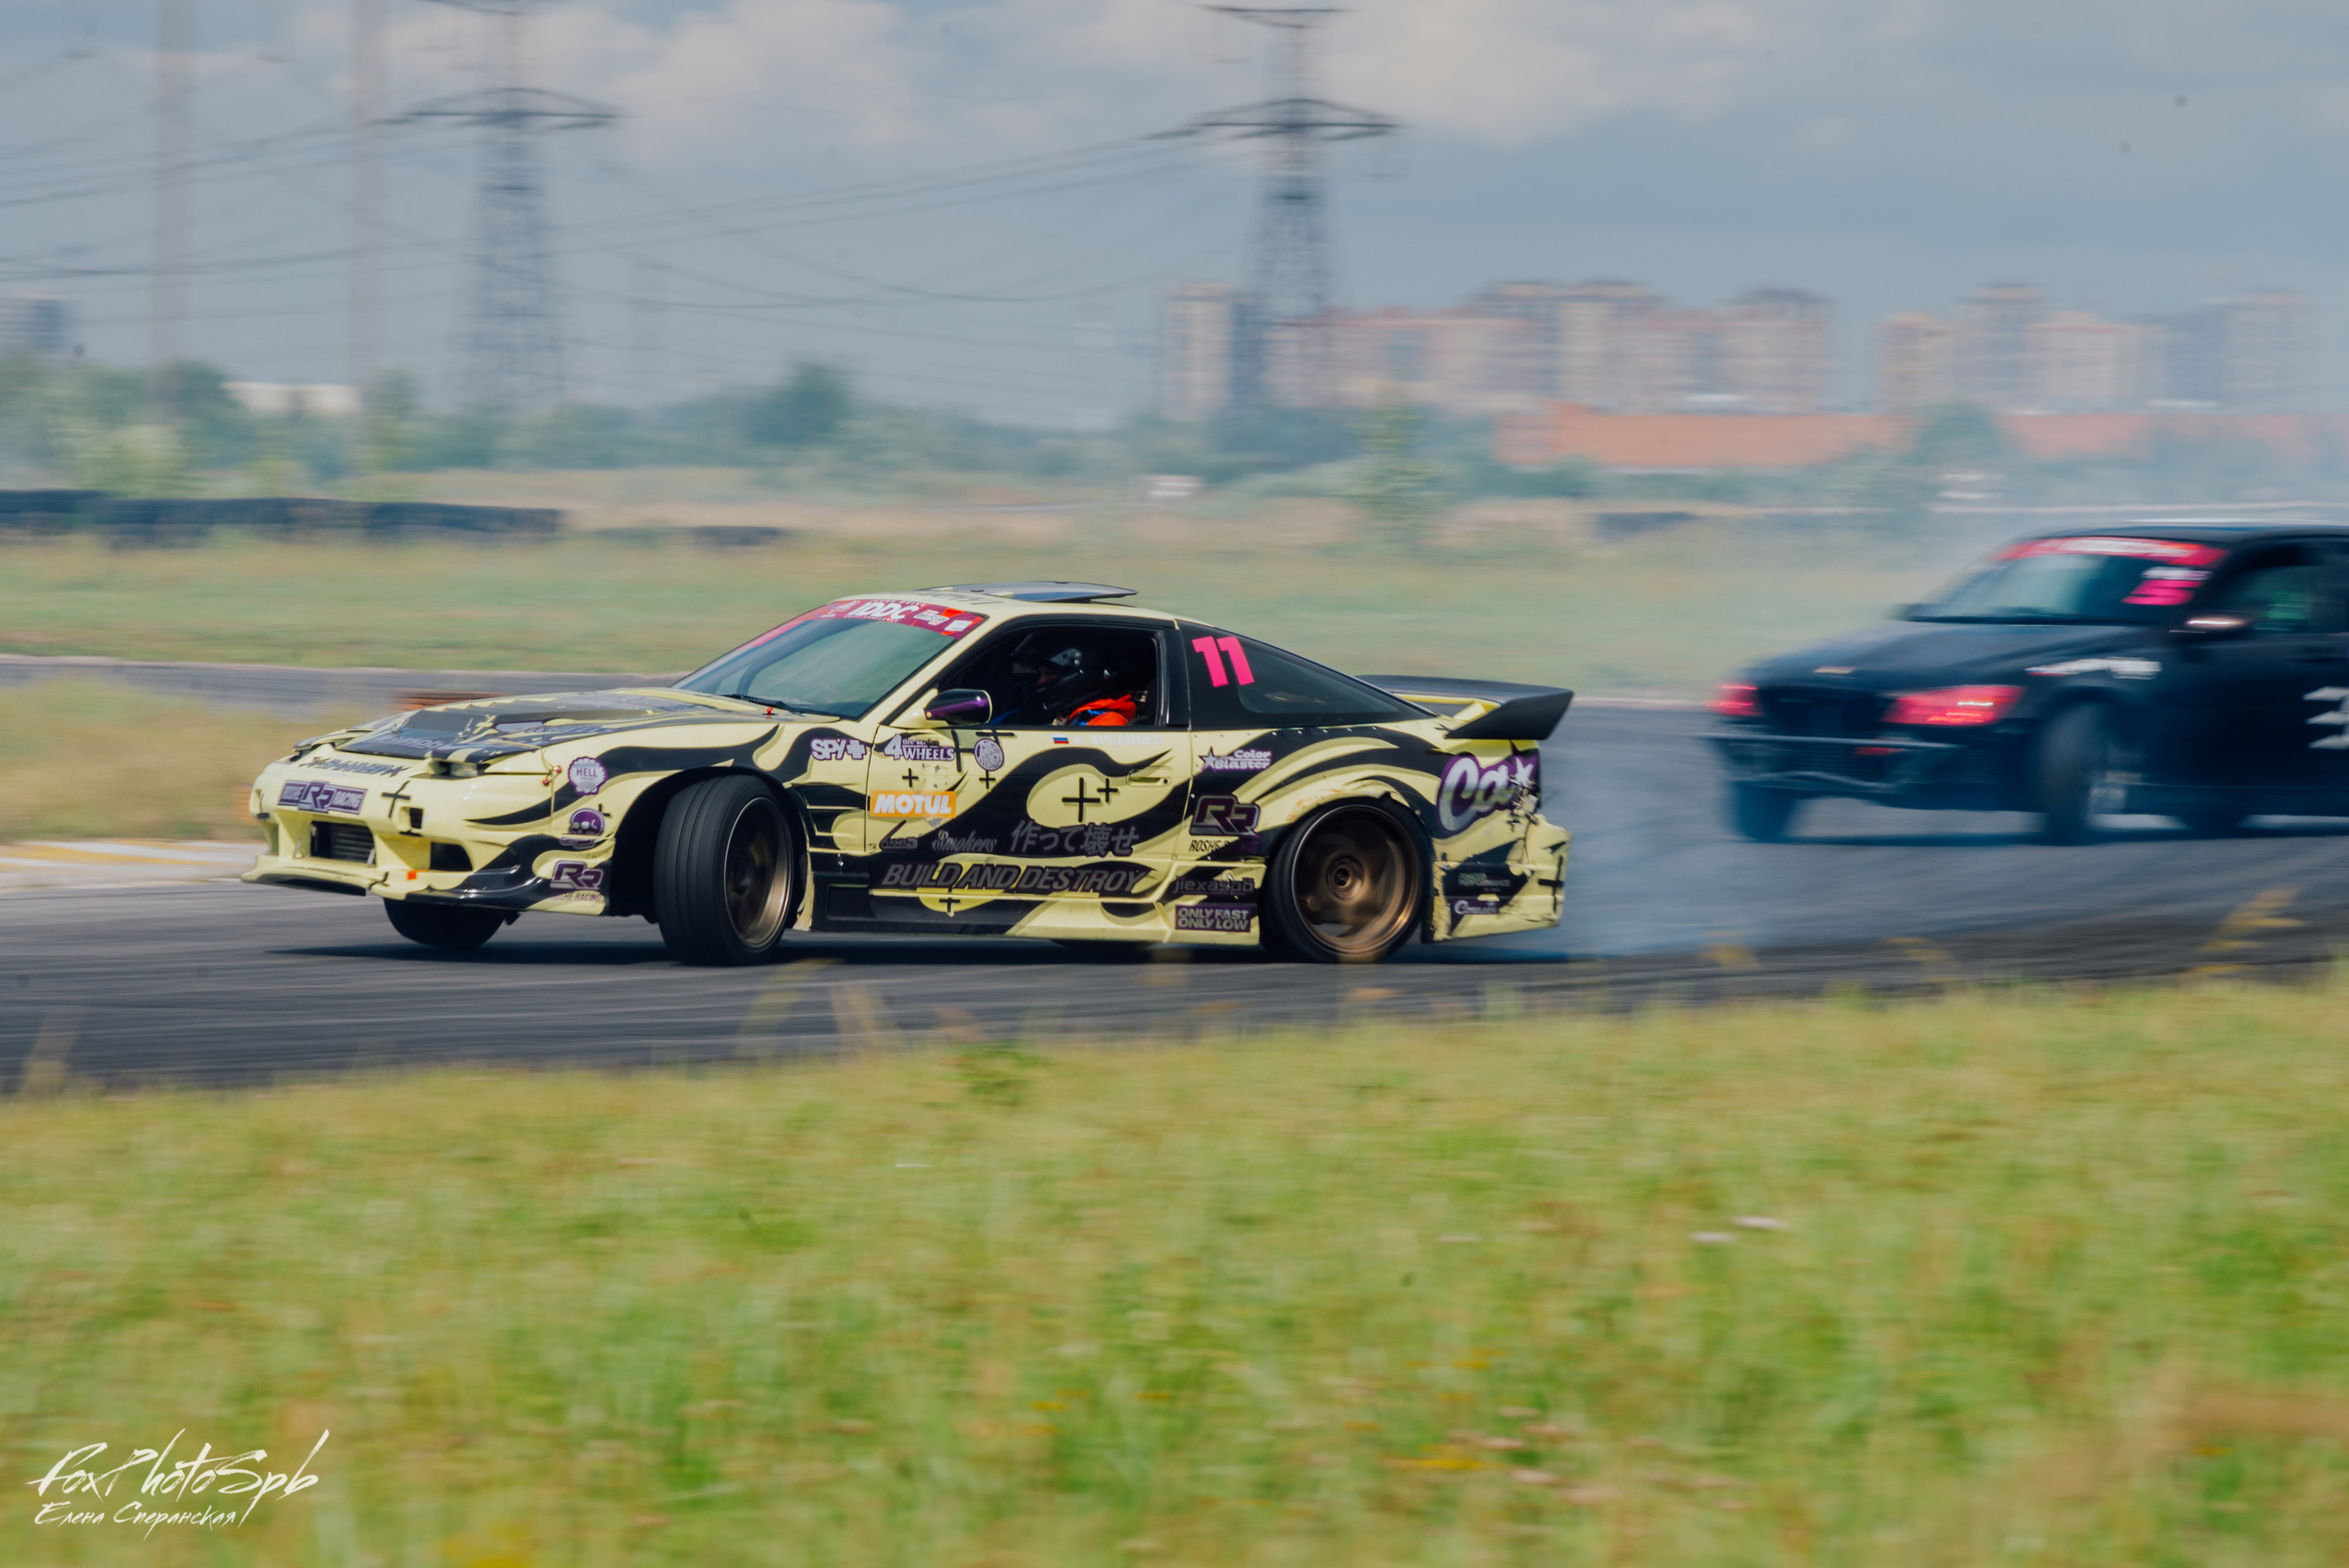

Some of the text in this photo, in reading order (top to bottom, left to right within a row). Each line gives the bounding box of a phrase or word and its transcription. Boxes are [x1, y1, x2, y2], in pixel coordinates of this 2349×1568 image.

[848, 601, 919, 620] IDDC
[1192, 635, 1254, 687] 11
[903, 747, 955, 762] WHEELS
[1233, 750, 1272, 760] Color
[576, 767, 598, 778] HELL
[1215, 760, 1271, 769] Blaster
[874, 794, 952, 814] MOTUL
[931, 829, 997, 852] Smokers
[1010, 821, 1140, 856] 作って壊せ
[882, 862, 1146, 893] BUILD AND DESTROY
[1177, 907, 1249, 919] ONLY FAST
[1177, 918, 1249, 930] ONLY LOW
